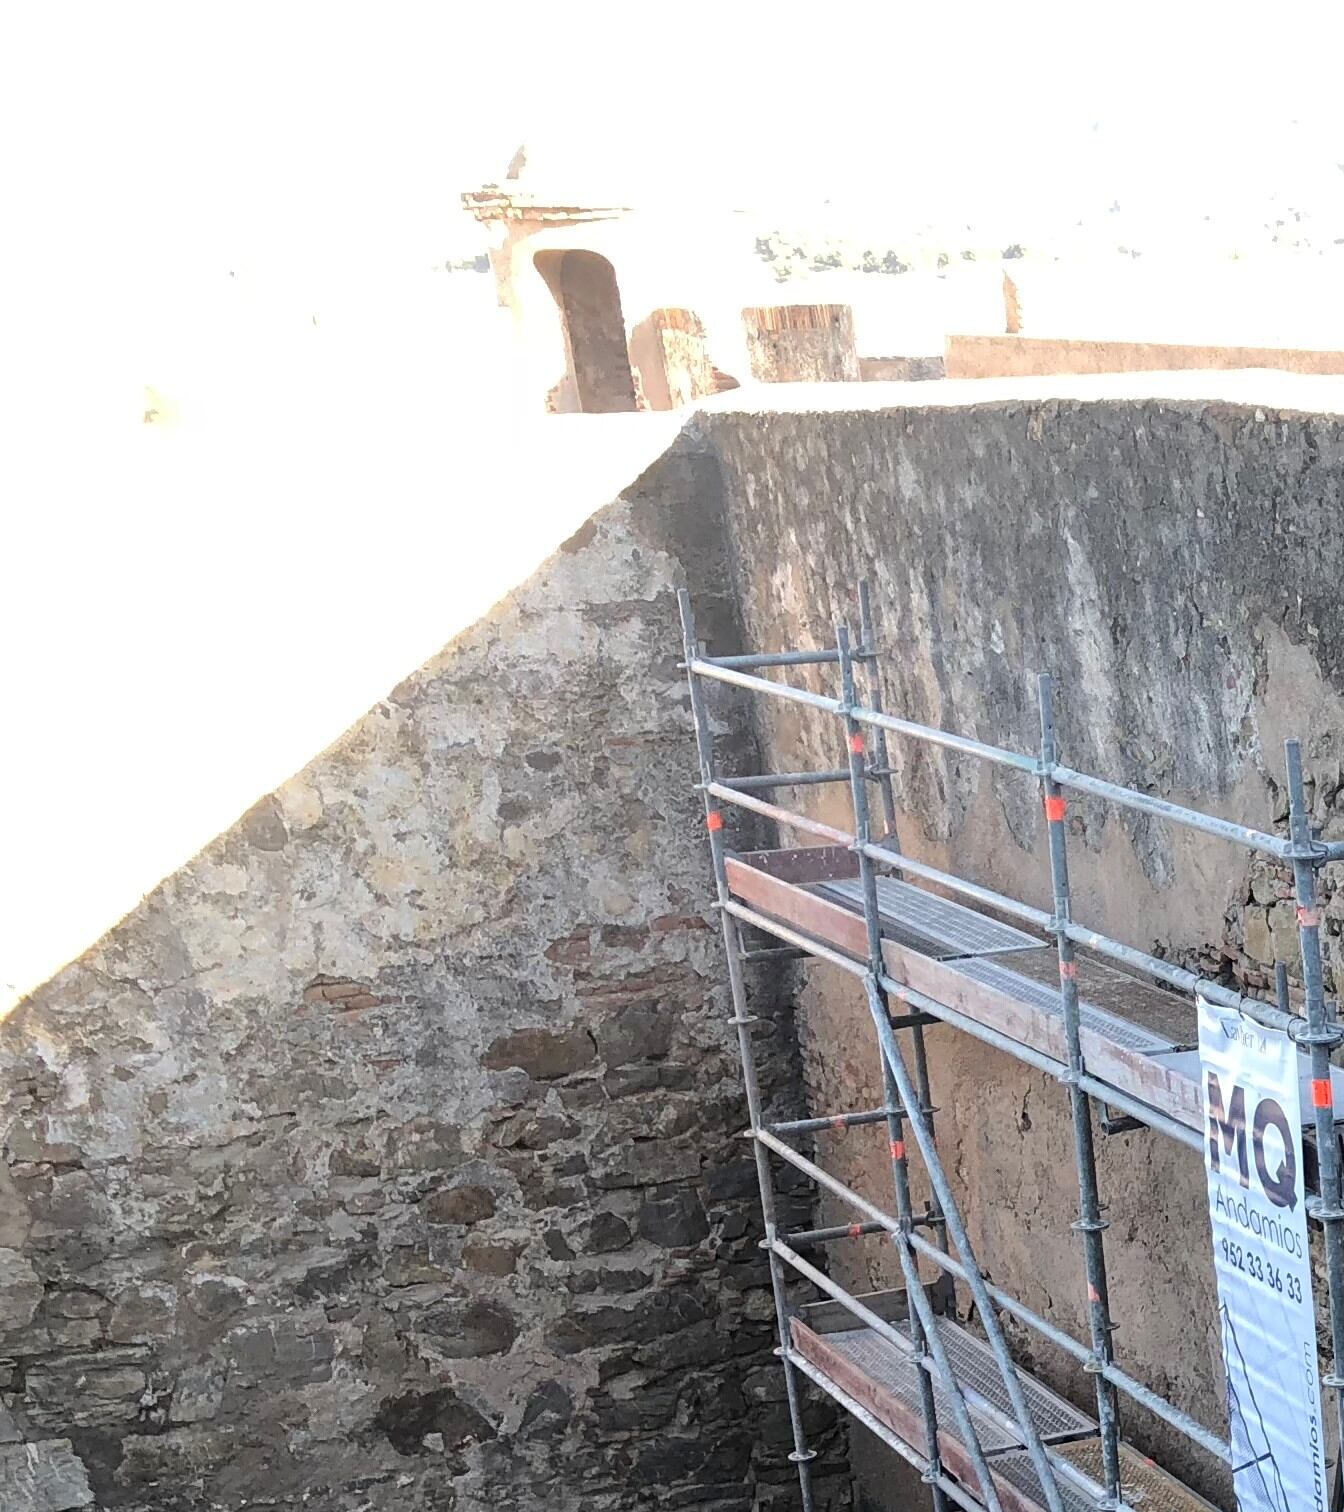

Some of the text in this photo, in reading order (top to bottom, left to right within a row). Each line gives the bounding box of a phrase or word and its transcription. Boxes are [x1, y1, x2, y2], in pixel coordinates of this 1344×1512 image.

[1208, 1071, 1298, 1213] MQ
[1216, 1184, 1302, 1258] Andamios
[1221, 1237, 1303, 1304] 952 33 36 33
